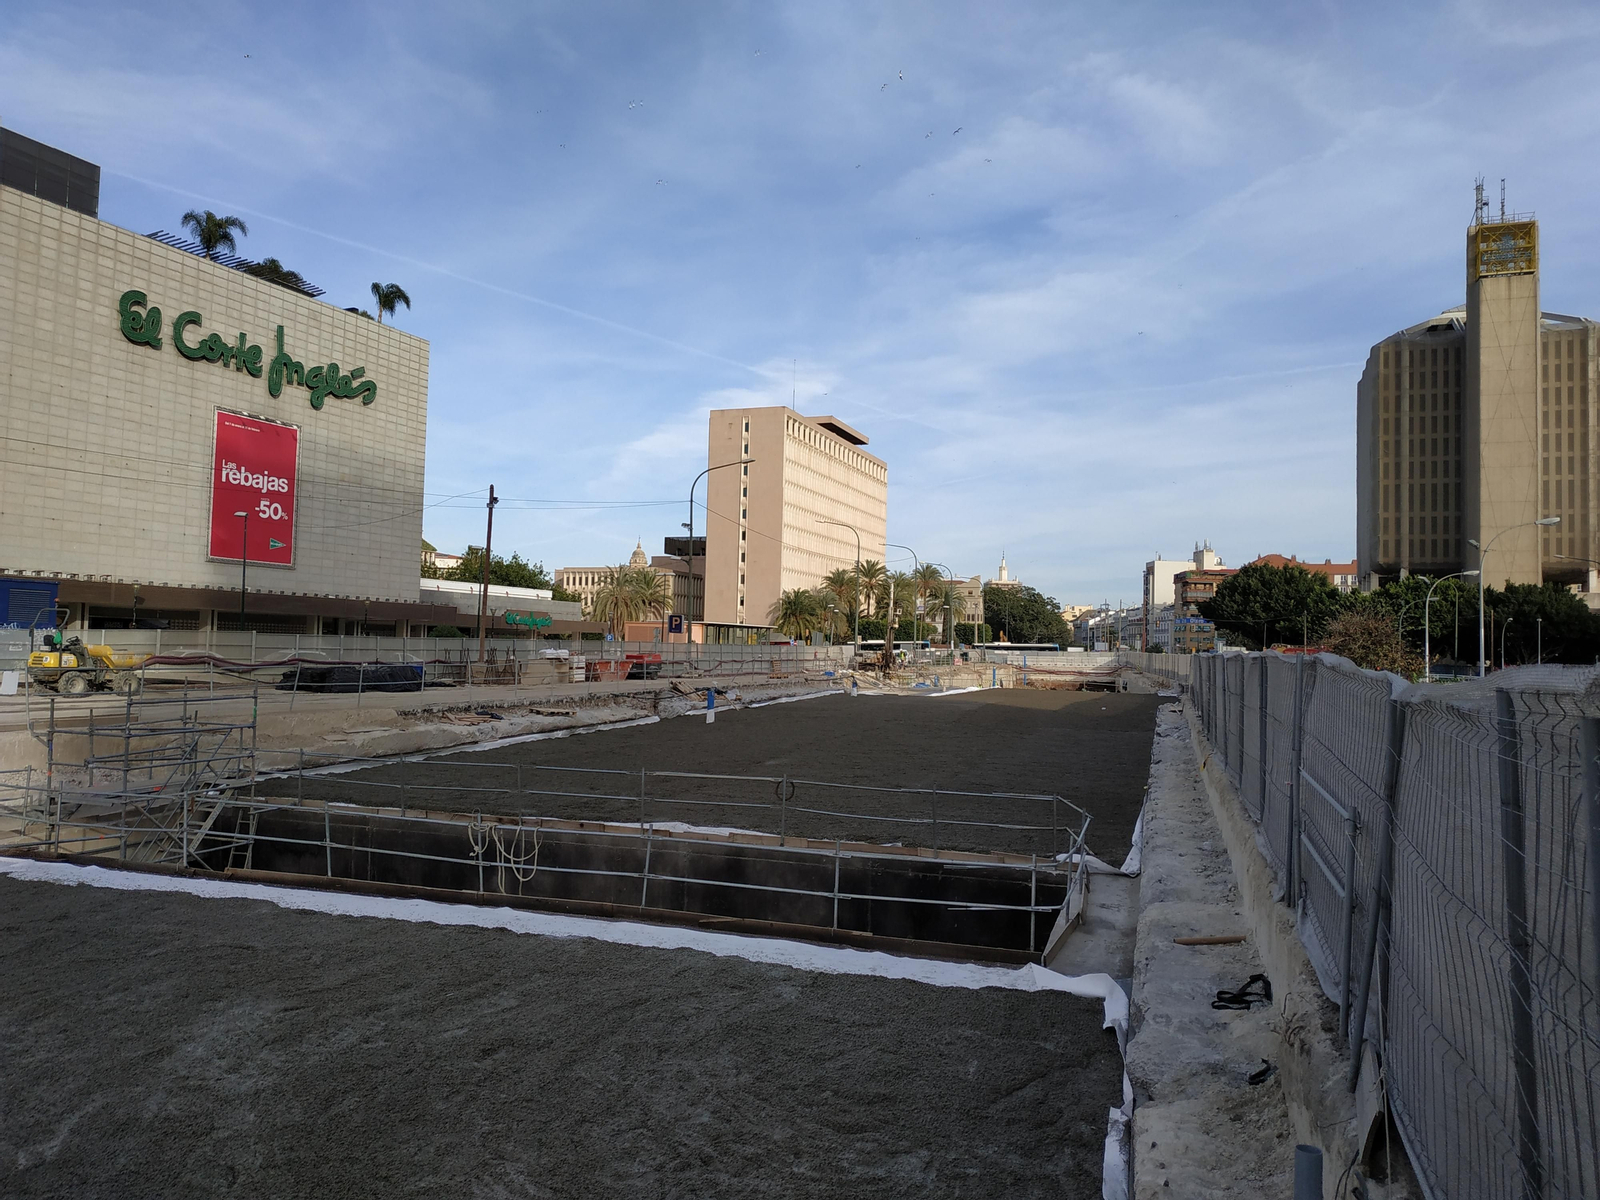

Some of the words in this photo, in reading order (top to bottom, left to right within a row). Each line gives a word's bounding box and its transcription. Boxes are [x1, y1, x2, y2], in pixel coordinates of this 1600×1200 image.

[119, 290, 163, 350] El
[173, 310, 263, 378] Corte
[267, 325, 377, 410] Inglés
[222, 459, 237, 469] Las
[221, 467, 289, 493] rebajas
[255, 500, 289, 520] -50%
[672, 617, 681, 629] P
